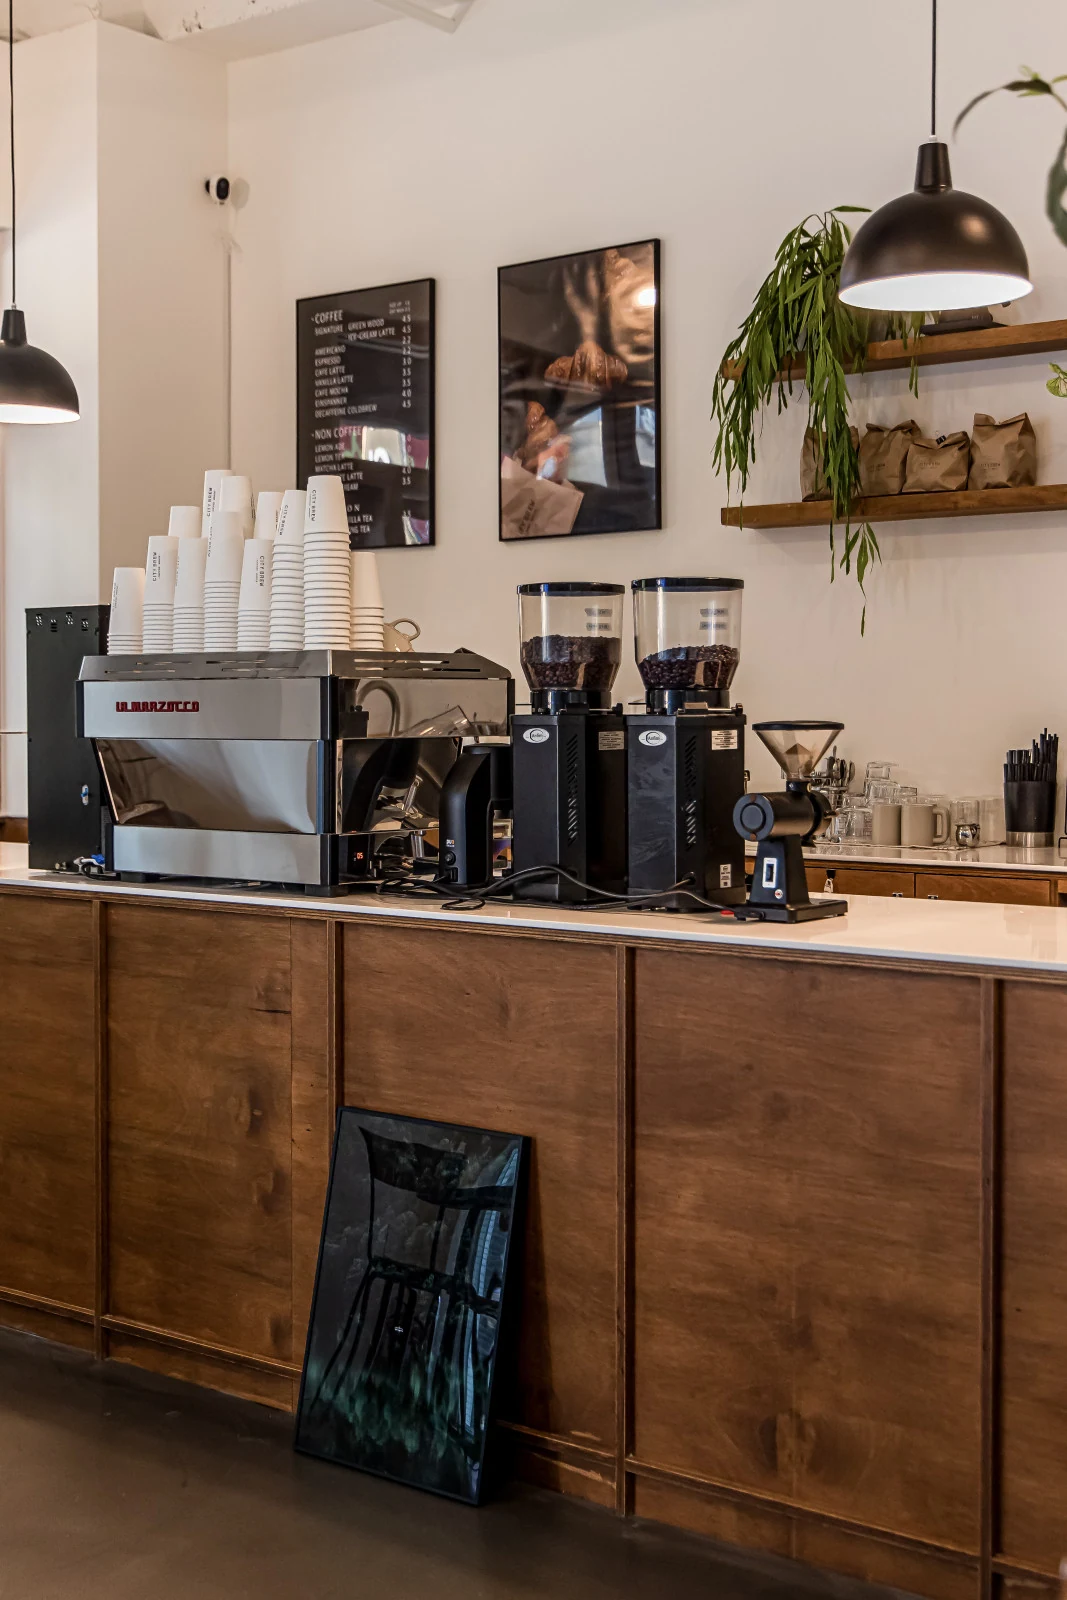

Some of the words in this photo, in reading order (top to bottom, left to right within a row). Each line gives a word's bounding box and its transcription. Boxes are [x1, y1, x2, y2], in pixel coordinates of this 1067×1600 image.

[314, 310, 343, 324] COFFEE
[314, 345, 346, 356] AMERICANO
[314, 356, 342, 367] ESPRESSO
[328, 365, 346, 376] LATTE
[337, 374, 354, 385] LATTE
[314, 428, 332, 440] NON
[333, 425, 362, 438] COFFEE
[130, 701, 200, 713] MARZOCCO
